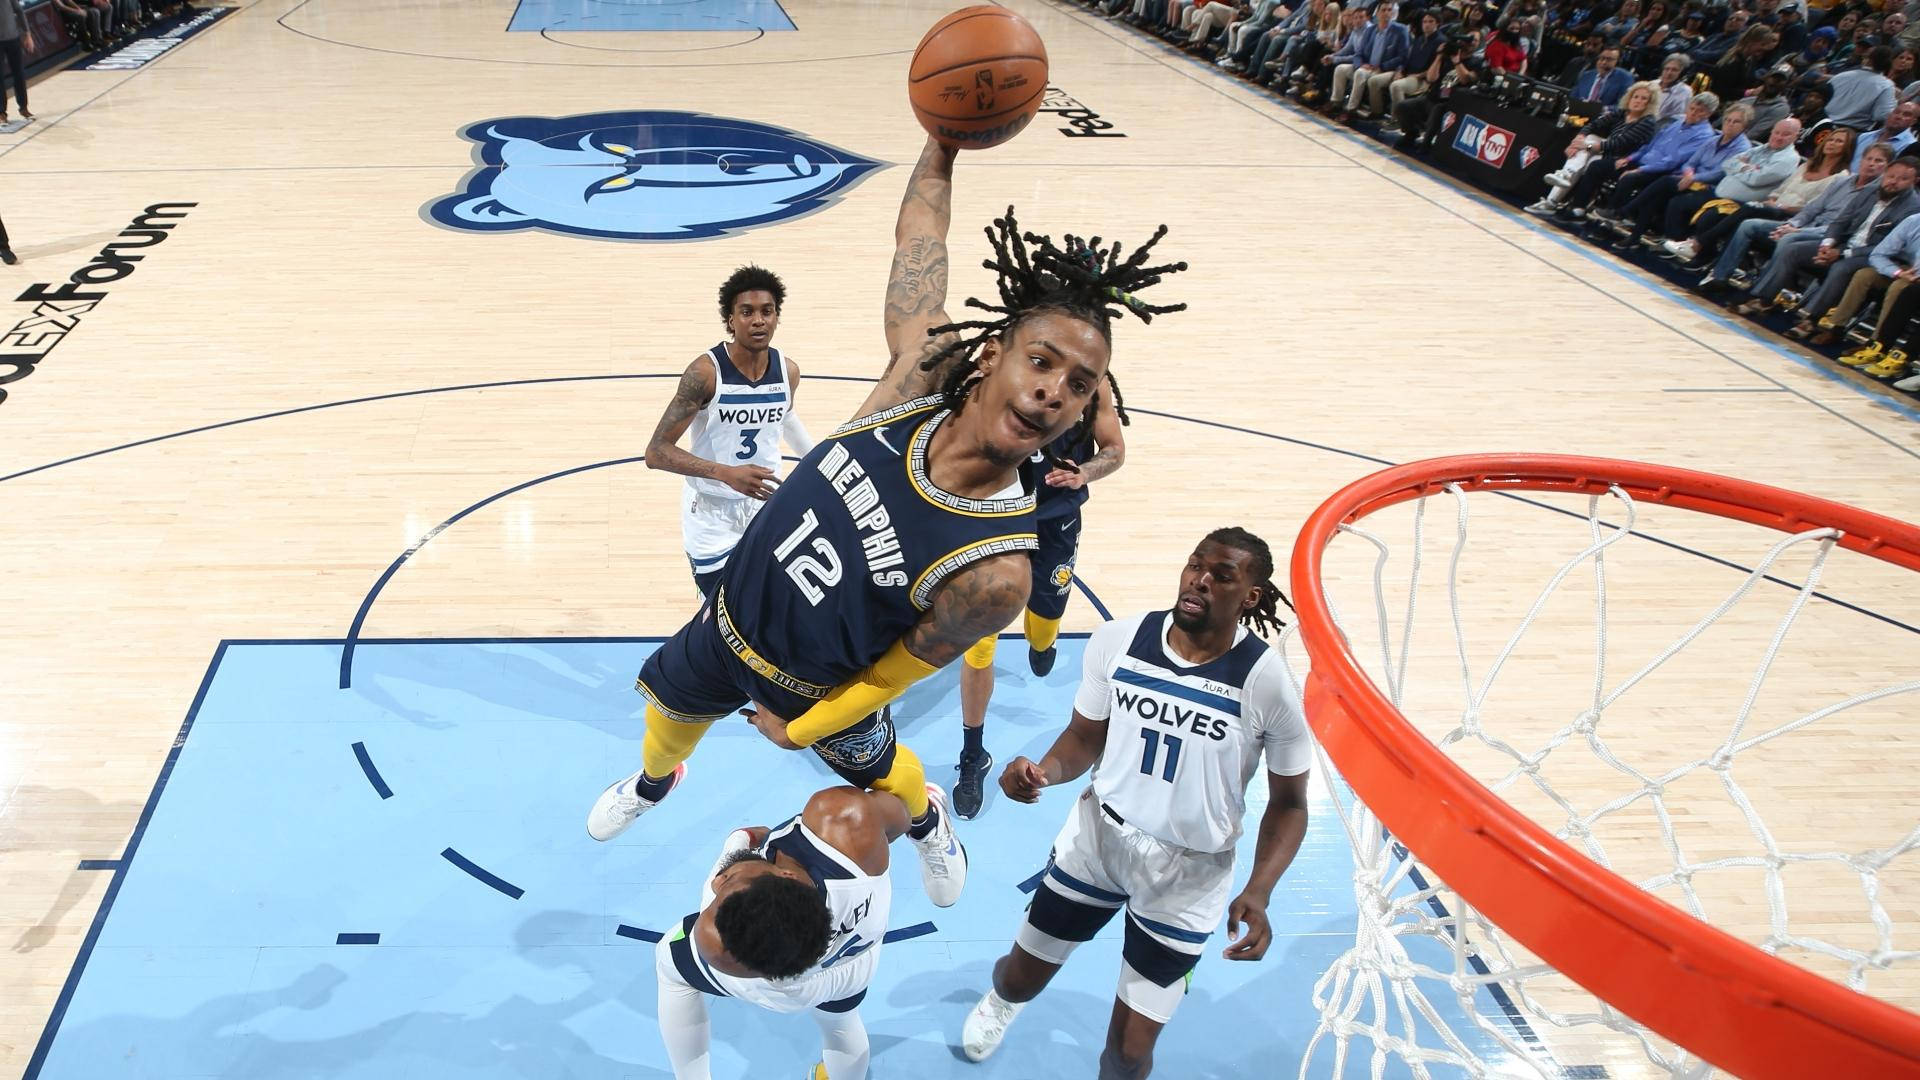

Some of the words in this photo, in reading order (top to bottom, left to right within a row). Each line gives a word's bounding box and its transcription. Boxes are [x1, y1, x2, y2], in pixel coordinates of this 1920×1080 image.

[718, 407, 783, 424] WOLVES
[736, 429, 760, 460] 3
[817, 441, 909, 587] MEMPHIS
[773, 508, 843, 607] 12
[1116, 688, 1229, 741] WOLVES
[1140, 727, 1182, 784] 11
[830, 891, 873, 942] LEY
